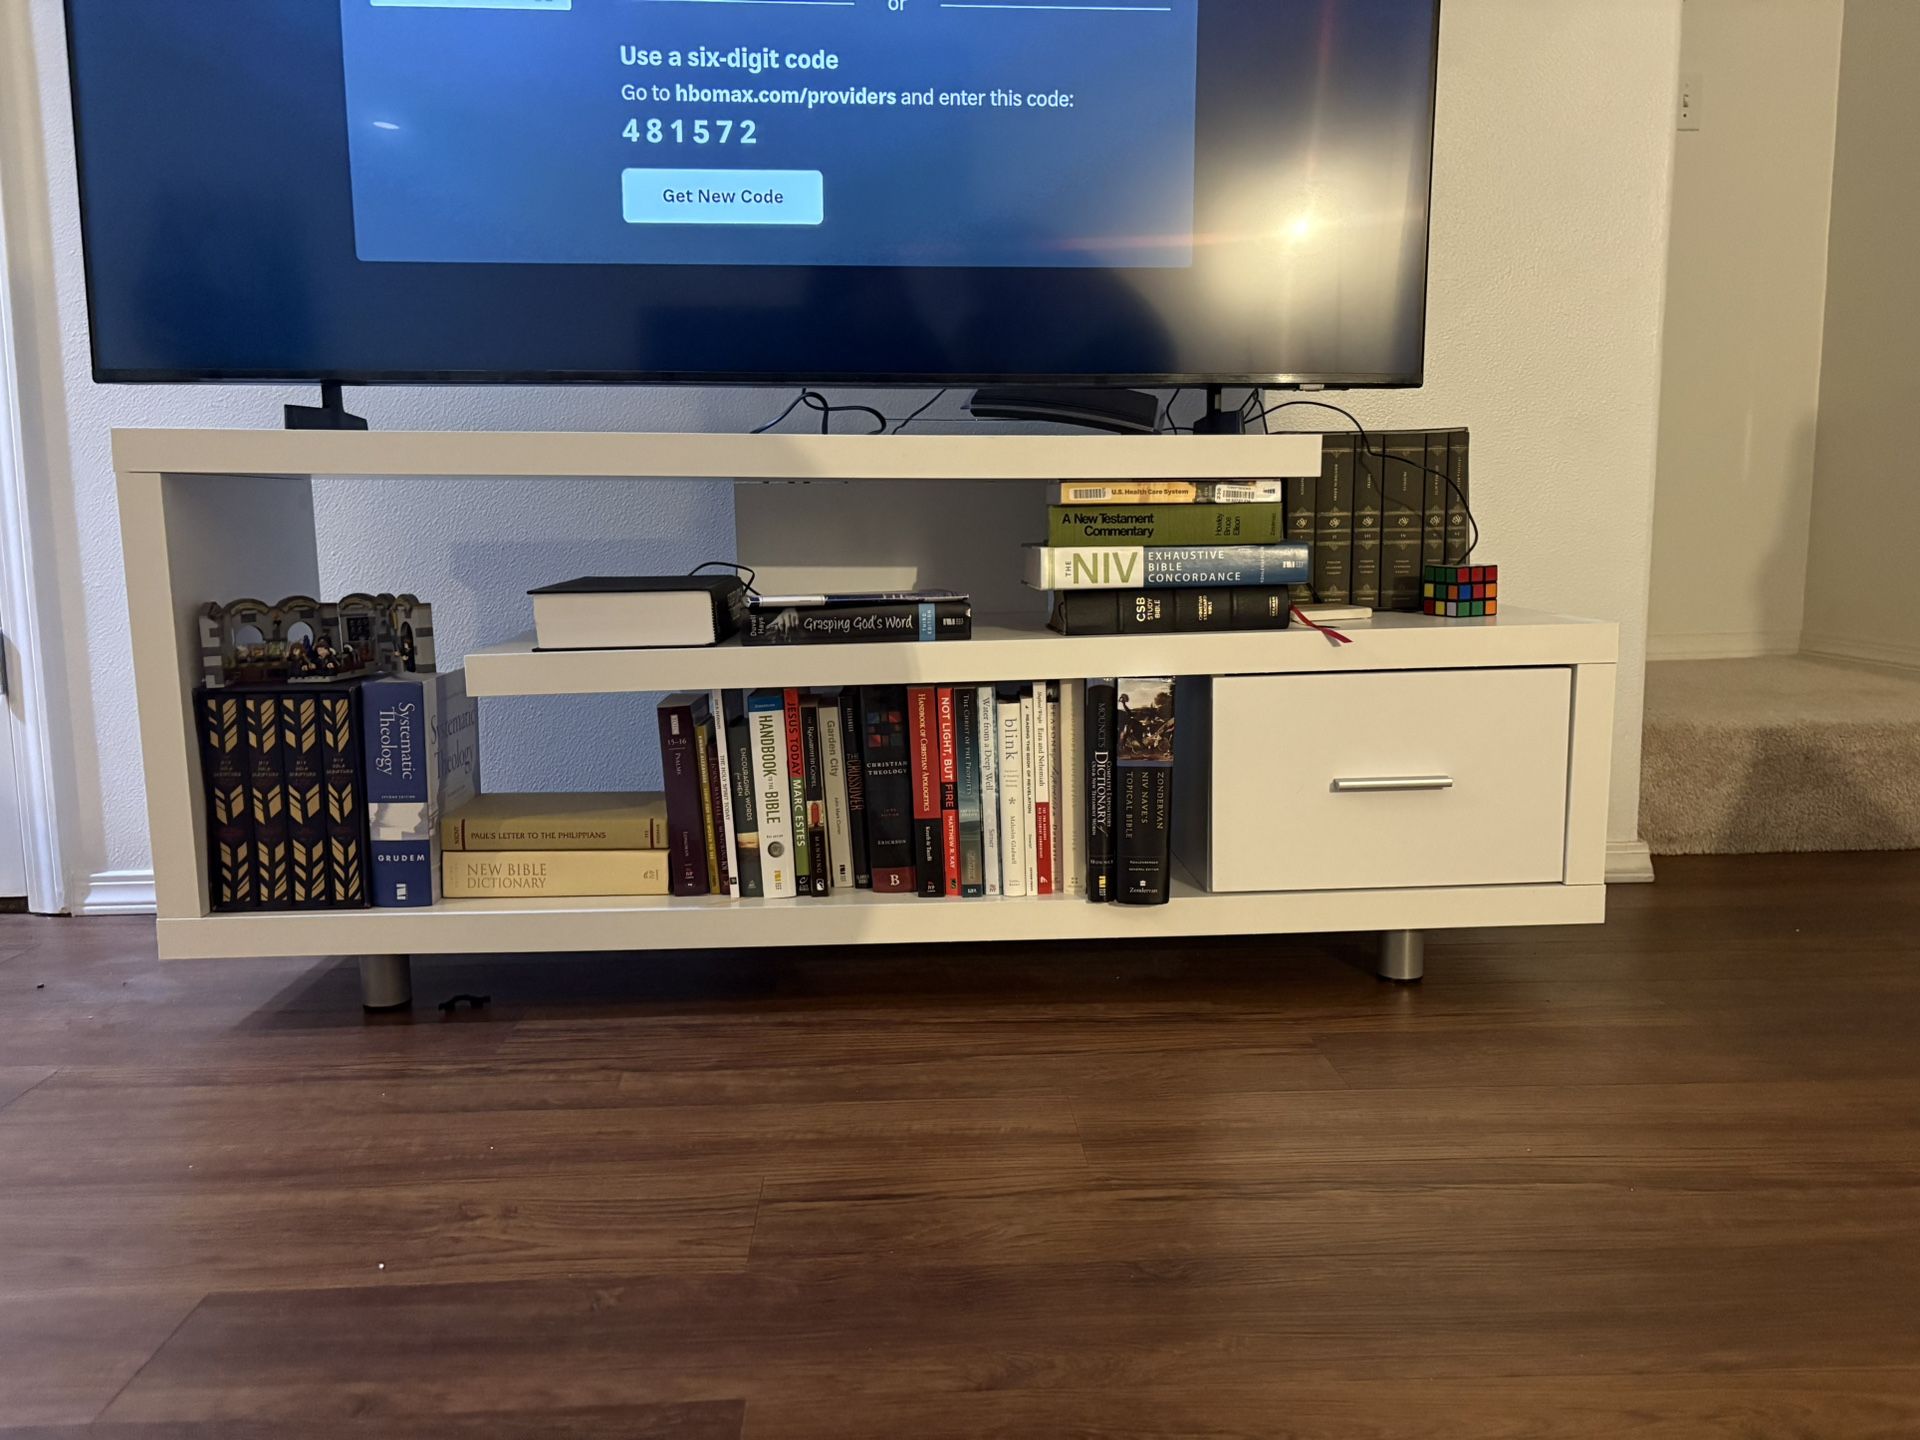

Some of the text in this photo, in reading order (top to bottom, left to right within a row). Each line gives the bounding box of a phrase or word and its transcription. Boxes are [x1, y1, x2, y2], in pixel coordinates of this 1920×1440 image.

[888, 0, 907, 11] or
[620, 46, 839, 74] Use a six-digit code
[621, 84, 1074, 108] Go to hbomax.com/providers and enter this code:
[663, 189, 784, 204] Get New Code
[1163, 489, 1189, 497] System
[1062, 512, 1155, 525] A New Testament
[1084, 525, 1155, 538] Commentary
[1148, 550, 1225, 561] EXHAUSTIVE
[1148, 562, 1182, 572] BIBLE
[1073, 552, 1138, 584] NIV
[1148, 572, 1241, 583] CONCORDANCE
[1136, 597, 1146, 622] CSB
[757, 616, 765, 634] Hays
[803, 614, 913, 634] Grasping God's Word
[982, 697, 990, 721] Water
[963, 709, 971, 734] CHRIST
[983, 722, 991, 742] from
[1097, 702, 1106, 748] MOUNCE'S
[375, 706, 400, 776] Theology
[398, 702, 416, 781] Systematic
[758, 714, 777, 777] HANDBOOK
[826, 720, 839, 777] Garden City
[964, 736, 971, 745] OF
[1004, 717, 1019, 760] blink
[866, 760, 908, 768] CHRISTIAN
[917, 693, 930, 812] HANDBOOK OF CHRISTIAN APOLOGETICS
[941, 697, 954, 808] NOT LIGHT, BUT FIRE
[983, 750, 992, 771] Deep
[787, 702, 806, 847] JESUS TODAY MARC ESTES
[846, 752, 865, 811] THE CROSSOVER
[867, 768, 908, 776] THEOLOGY
[965, 762, 973, 796] PROPHETS
[985, 772, 994, 791] Well
[1026, 769, 1031, 777] OF
[1038, 755, 1046, 787] Nehemiah
[736, 781, 744, 797] MEN
[740, 747, 753, 822] ENCOURAGING WORDS
[1094, 751, 1109, 825] DICTIONARY
[764, 791, 781, 824] BIBLE
[1125, 771, 1134, 839] TOPICAL BIBLE
[1141, 771, 1149, 824] NIV NAVE'S
[1156, 771, 1165, 829] ZONDERVAN
[470, 831, 607, 840] PAUL'S LETTER TO THE PHILIPPIANS
[378, 854, 425, 862] GRUDEM
[467, 863, 547, 877] NEW BIBLE
[467, 877, 547, 889] DICTIONARY
[890, 873, 900, 886] B
